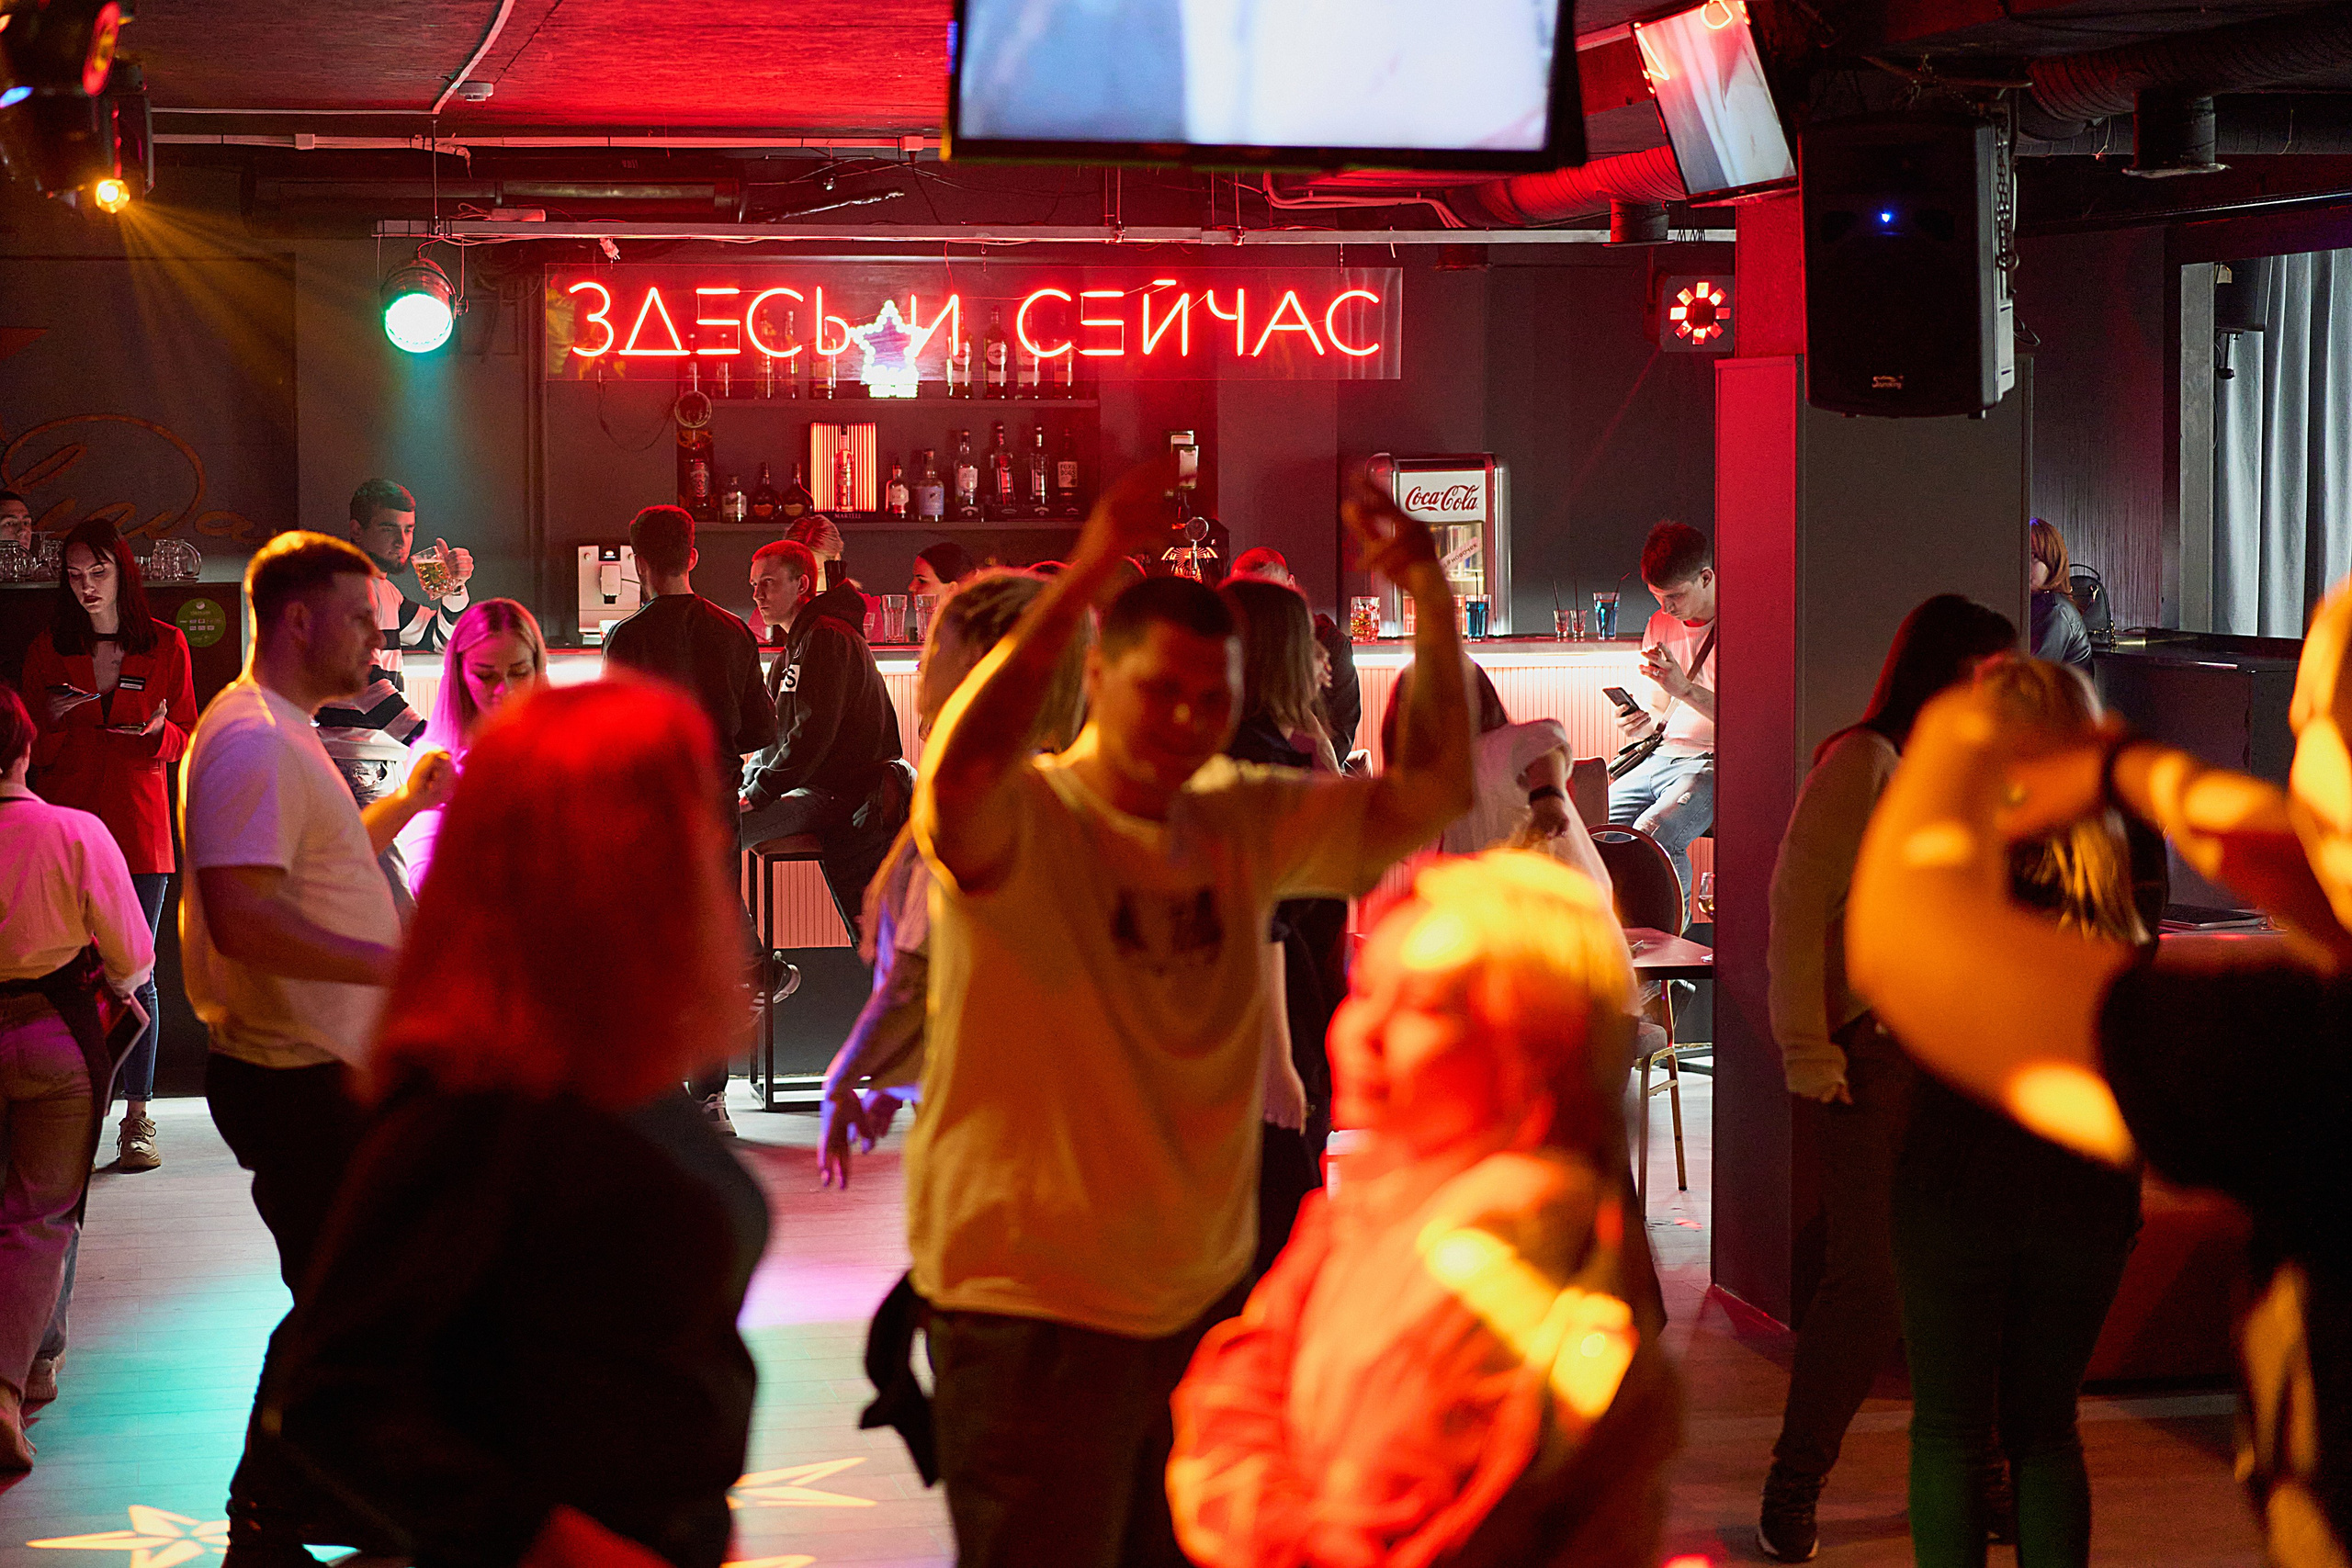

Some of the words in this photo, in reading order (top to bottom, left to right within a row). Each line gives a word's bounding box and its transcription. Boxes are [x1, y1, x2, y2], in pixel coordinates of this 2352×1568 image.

[569, 281, 851, 359] ЗДЕСЬ
[910, 293, 959, 357] И
[1016, 279, 1380, 357] СЕЙЧАС
[1405, 484, 1480, 513] Coca-Cola
